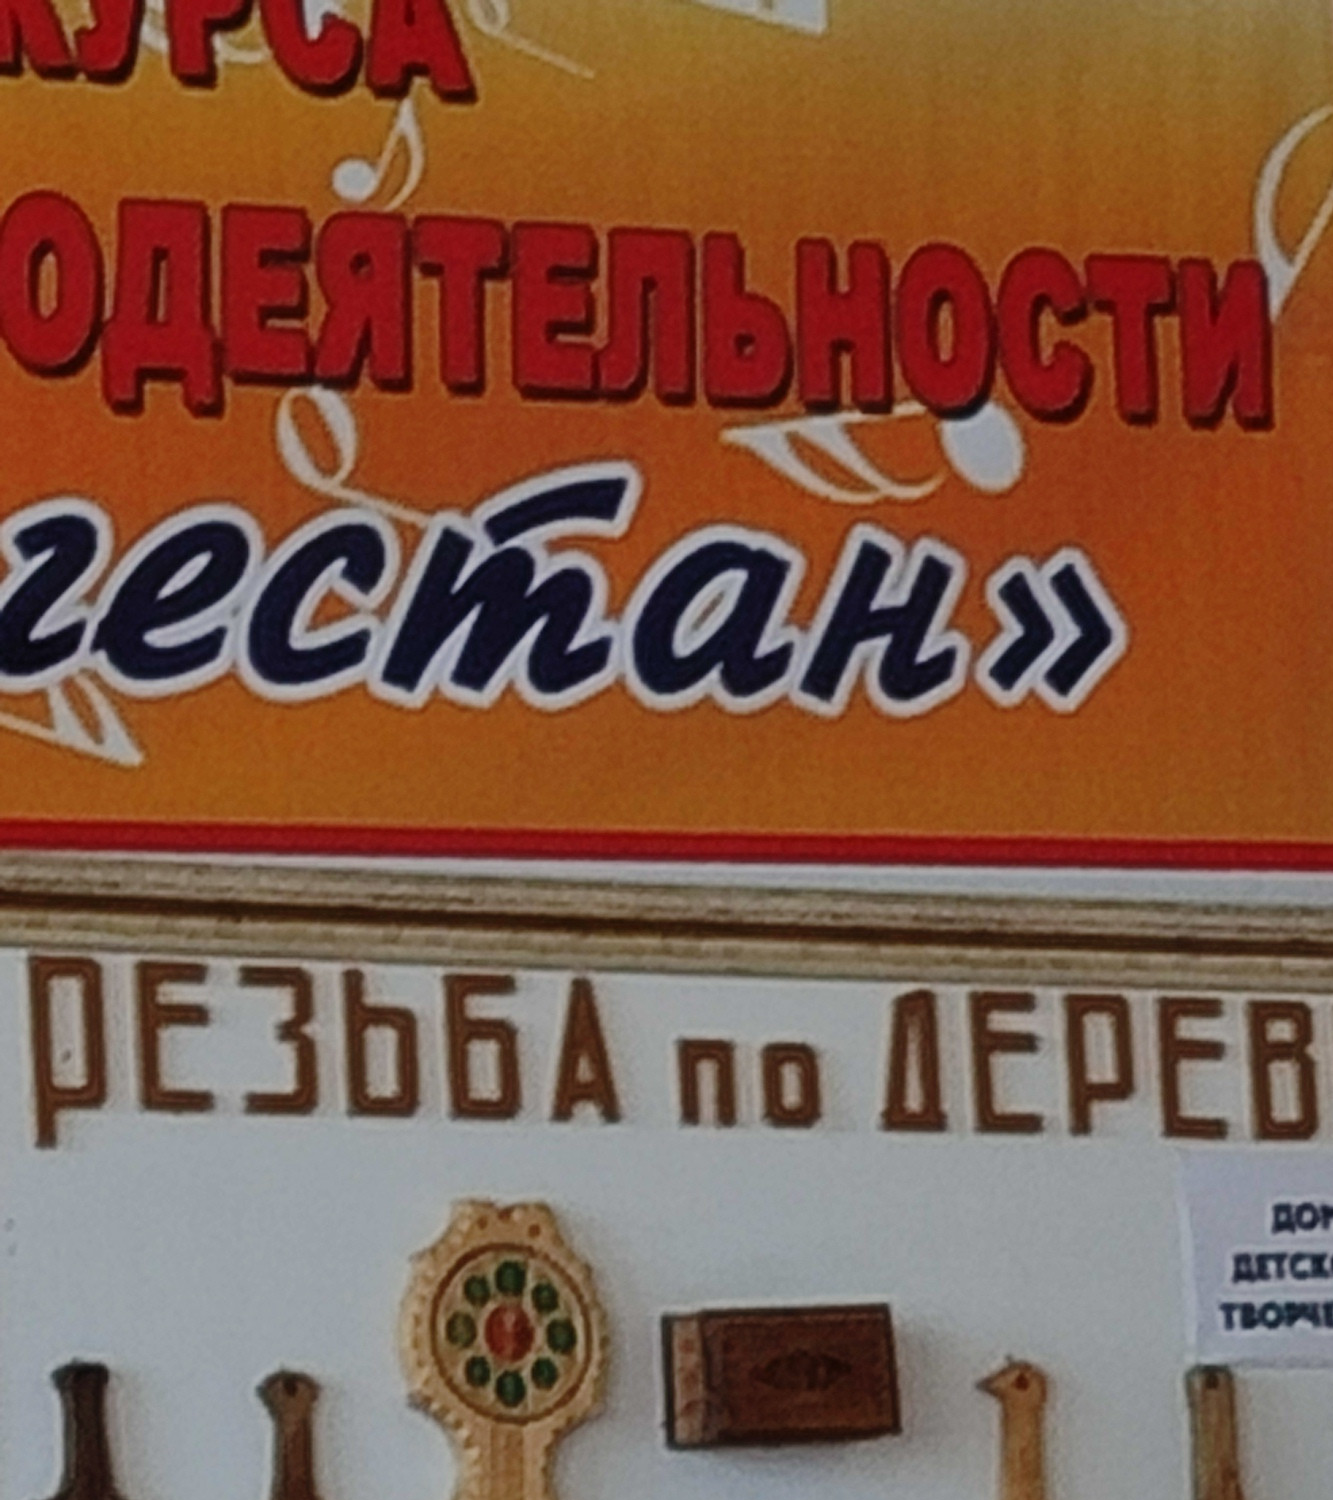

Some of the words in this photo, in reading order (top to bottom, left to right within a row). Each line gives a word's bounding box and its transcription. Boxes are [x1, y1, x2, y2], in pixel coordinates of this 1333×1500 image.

[0, 189, 1274, 430] ОДЕЯТЕЛЬНОСТИ
[0, 468, 1118, 708] гестан»
[26, 952, 624, 1149] РЕЗЬБА
[677, 1037, 824, 1129] по
